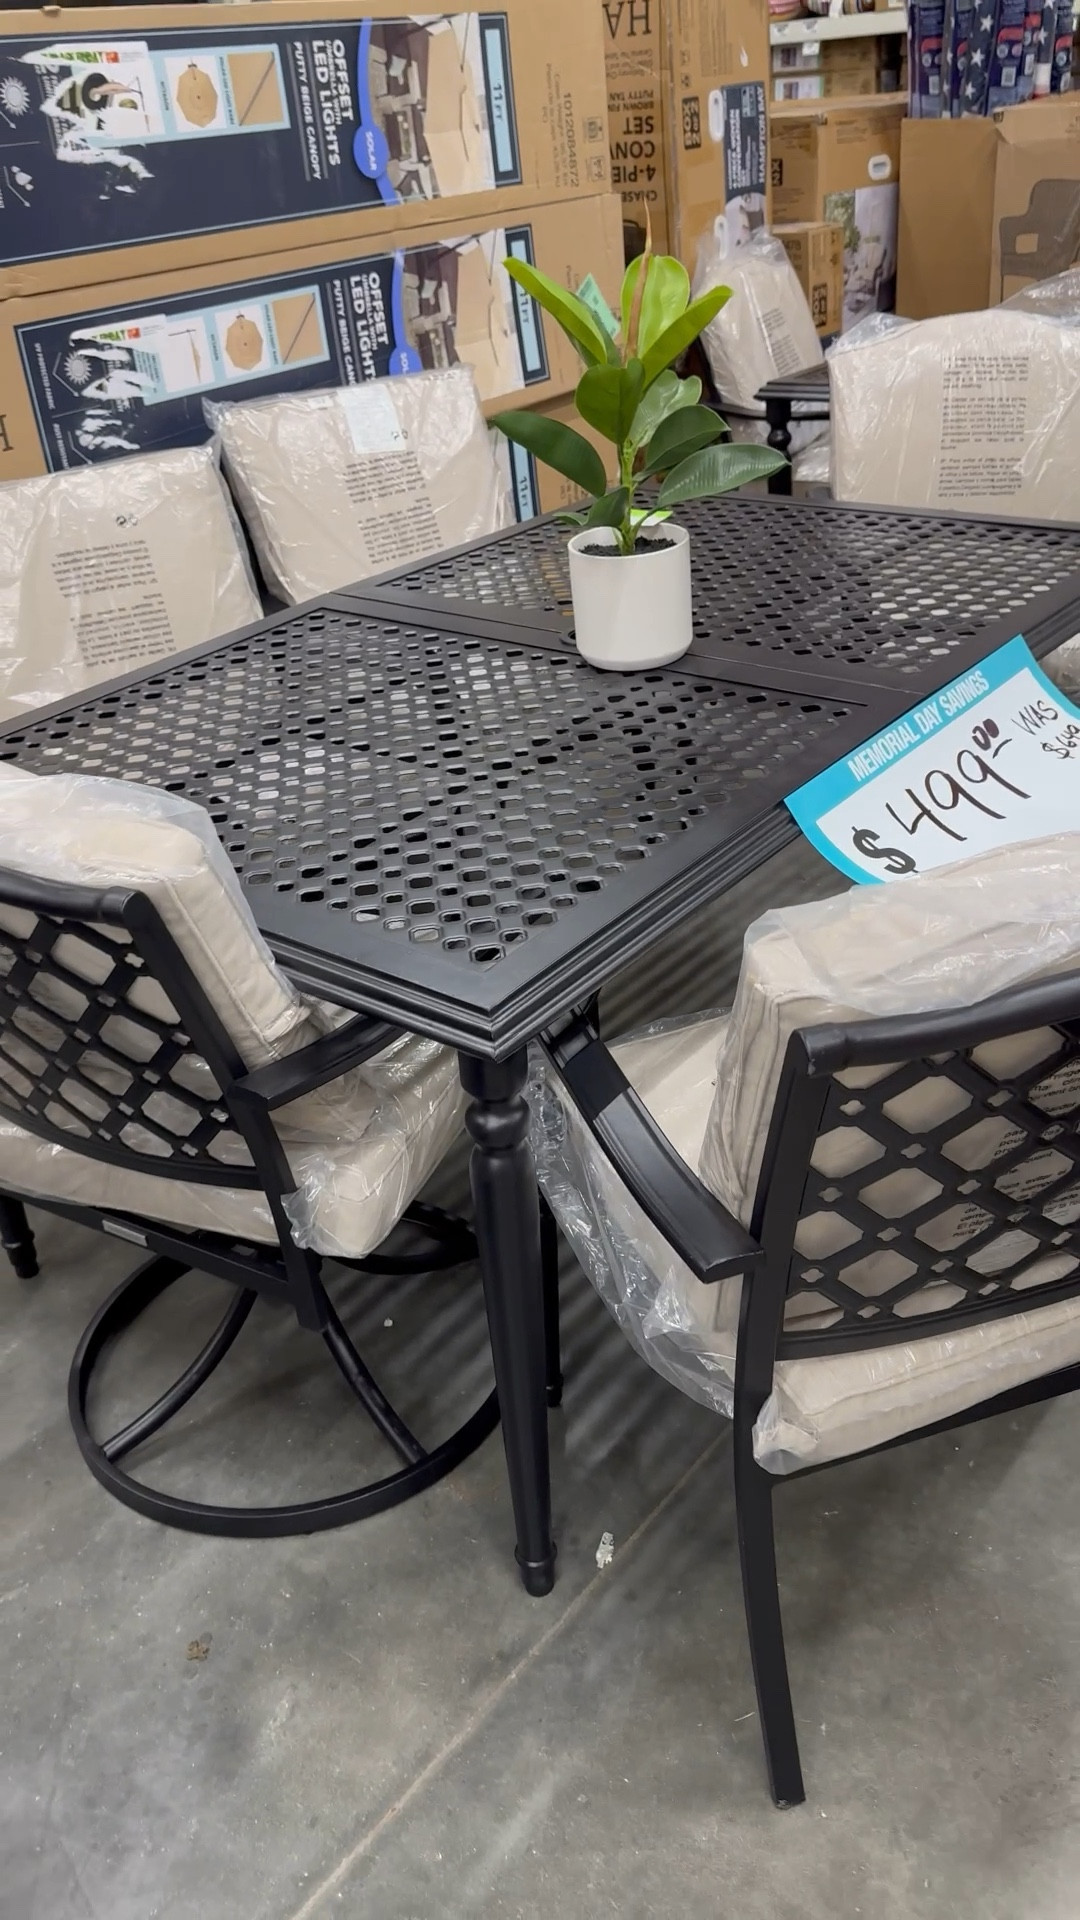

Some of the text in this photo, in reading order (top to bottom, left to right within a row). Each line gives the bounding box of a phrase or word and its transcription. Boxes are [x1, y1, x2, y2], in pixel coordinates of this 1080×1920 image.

[333, 39, 354, 121] OFFSET
[609, 89, 653, 101] PUTTY TAN
[293, 41, 321, 180] PUTTY BEIGE CANOPY
[312, 40, 341, 166] LED LIGHTS
[624, 101, 654, 111] BROWN
[623, 116, 654, 134] SET
[365, 131, 377, 171] SOLAR
[612, 165, 656, 183] 4-PIE
[333, 279, 345, 317] PUTTY
[350, 275, 365, 315] LED
[368, 271, 389, 345] OFFSET
[338, 319, 351, 354] BEIGE
[847, 670, 990, 782] MEMORIAL DAY SAVINGS
[1011, 700, 1058, 735] WAS
